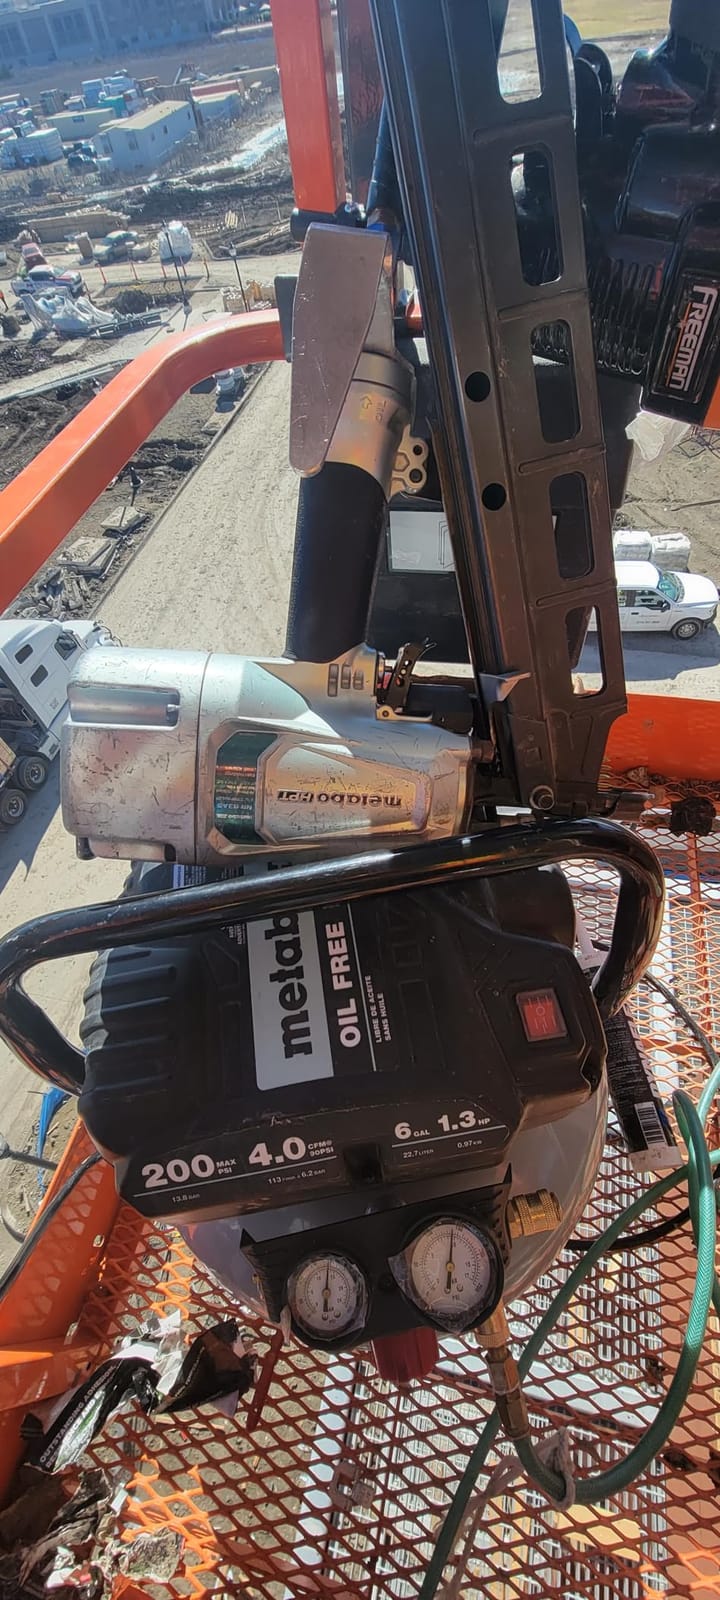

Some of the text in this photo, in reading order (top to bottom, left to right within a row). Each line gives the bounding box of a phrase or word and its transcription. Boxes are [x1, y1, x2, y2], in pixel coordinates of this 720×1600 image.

[669, 285, 718, 392] FREEMAN
[277, 790, 402, 809] metabo HPT
[264, 913, 313, 1059] metab
[325, 922, 361, 1048] OIL FREE
[364, 975, 383, 1043] LIBRE DE ACEITE
[377, 993, 392, 1041] SANS HUILE
[394, 1110, 491, 1139] 6 GAL 1.3 HP
[141, 1154, 237, 1188] 200 MAX
[218, 1167, 232, 1175] PSI
[248, 1136, 306, 1167] 4.0
[267, 1176, 281, 1185] 113
[301, 1170, 314, 1179] 6.2
[39, 1402, 85, 1463] OUTSTANDING
